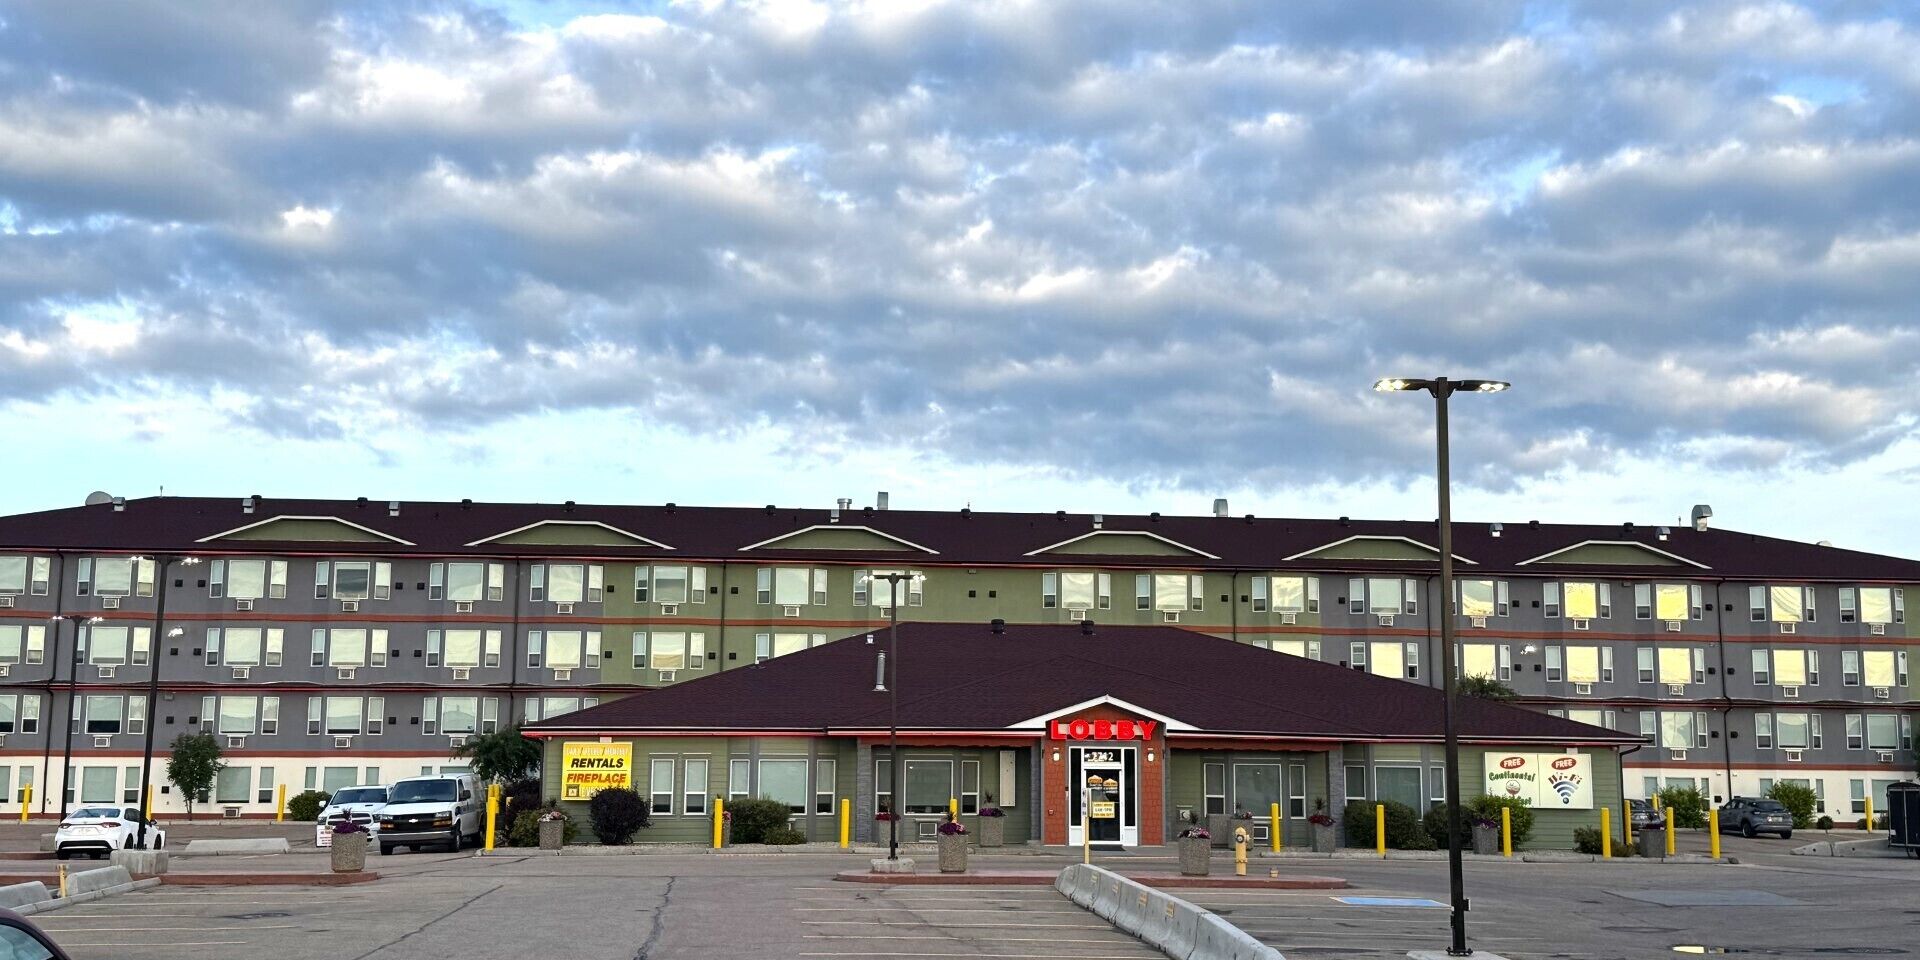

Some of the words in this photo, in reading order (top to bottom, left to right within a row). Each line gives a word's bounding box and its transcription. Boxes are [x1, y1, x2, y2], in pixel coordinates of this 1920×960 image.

[1051, 719, 1157, 740] LOBBY
[571, 758, 624, 768] RENTALS
[1503, 758, 1521, 768] FREE
[1556, 758, 1574, 768] FREE
[566, 773, 626, 783] FIREPLACE
[1489, 771, 1536, 782] Continental
[1548, 772, 1583, 784] Wi-Fi
